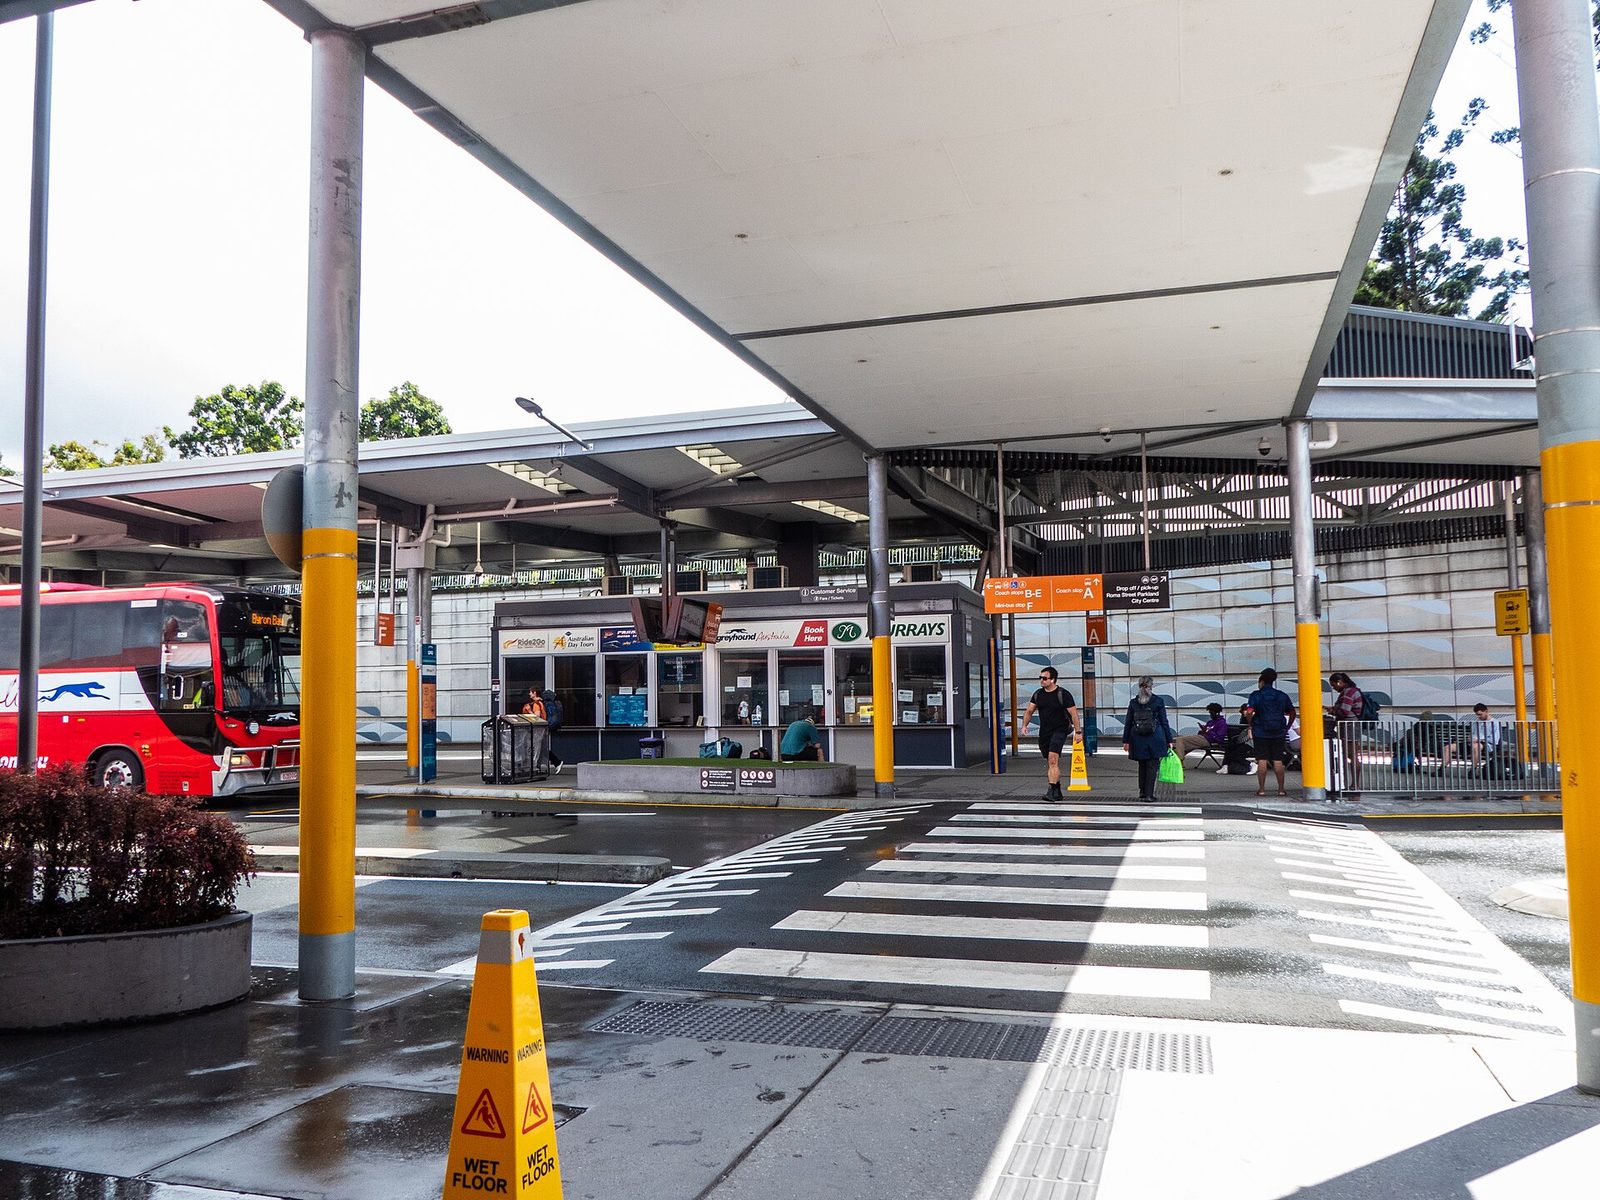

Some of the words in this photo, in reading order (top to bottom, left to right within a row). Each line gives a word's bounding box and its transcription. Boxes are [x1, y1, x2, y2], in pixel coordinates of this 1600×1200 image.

[1025, 588, 1042, 598] B-E
[1083, 587, 1094, 599] A
[1027, 602, 1034, 611] F
[251, 613, 272, 625] Byron
[378, 626, 388, 644] F
[804, 626, 825, 634] Book
[866, 622, 946, 637] URRAYS
[1087, 628, 1100, 644] A
[517, 638, 546, 646] Ride2Go
[716, 632, 757, 643] greyhound
[466, 1047, 509, 1064] WARNING
[516, 1039, 543, 1062] WARNING
[527, 1144, 549, 1169] WET
[464, 1157, 500, 1176] WET
[521, 1157, 555, 1190] FLOOR
[452, 1172, 508, 1194] FLOOR
